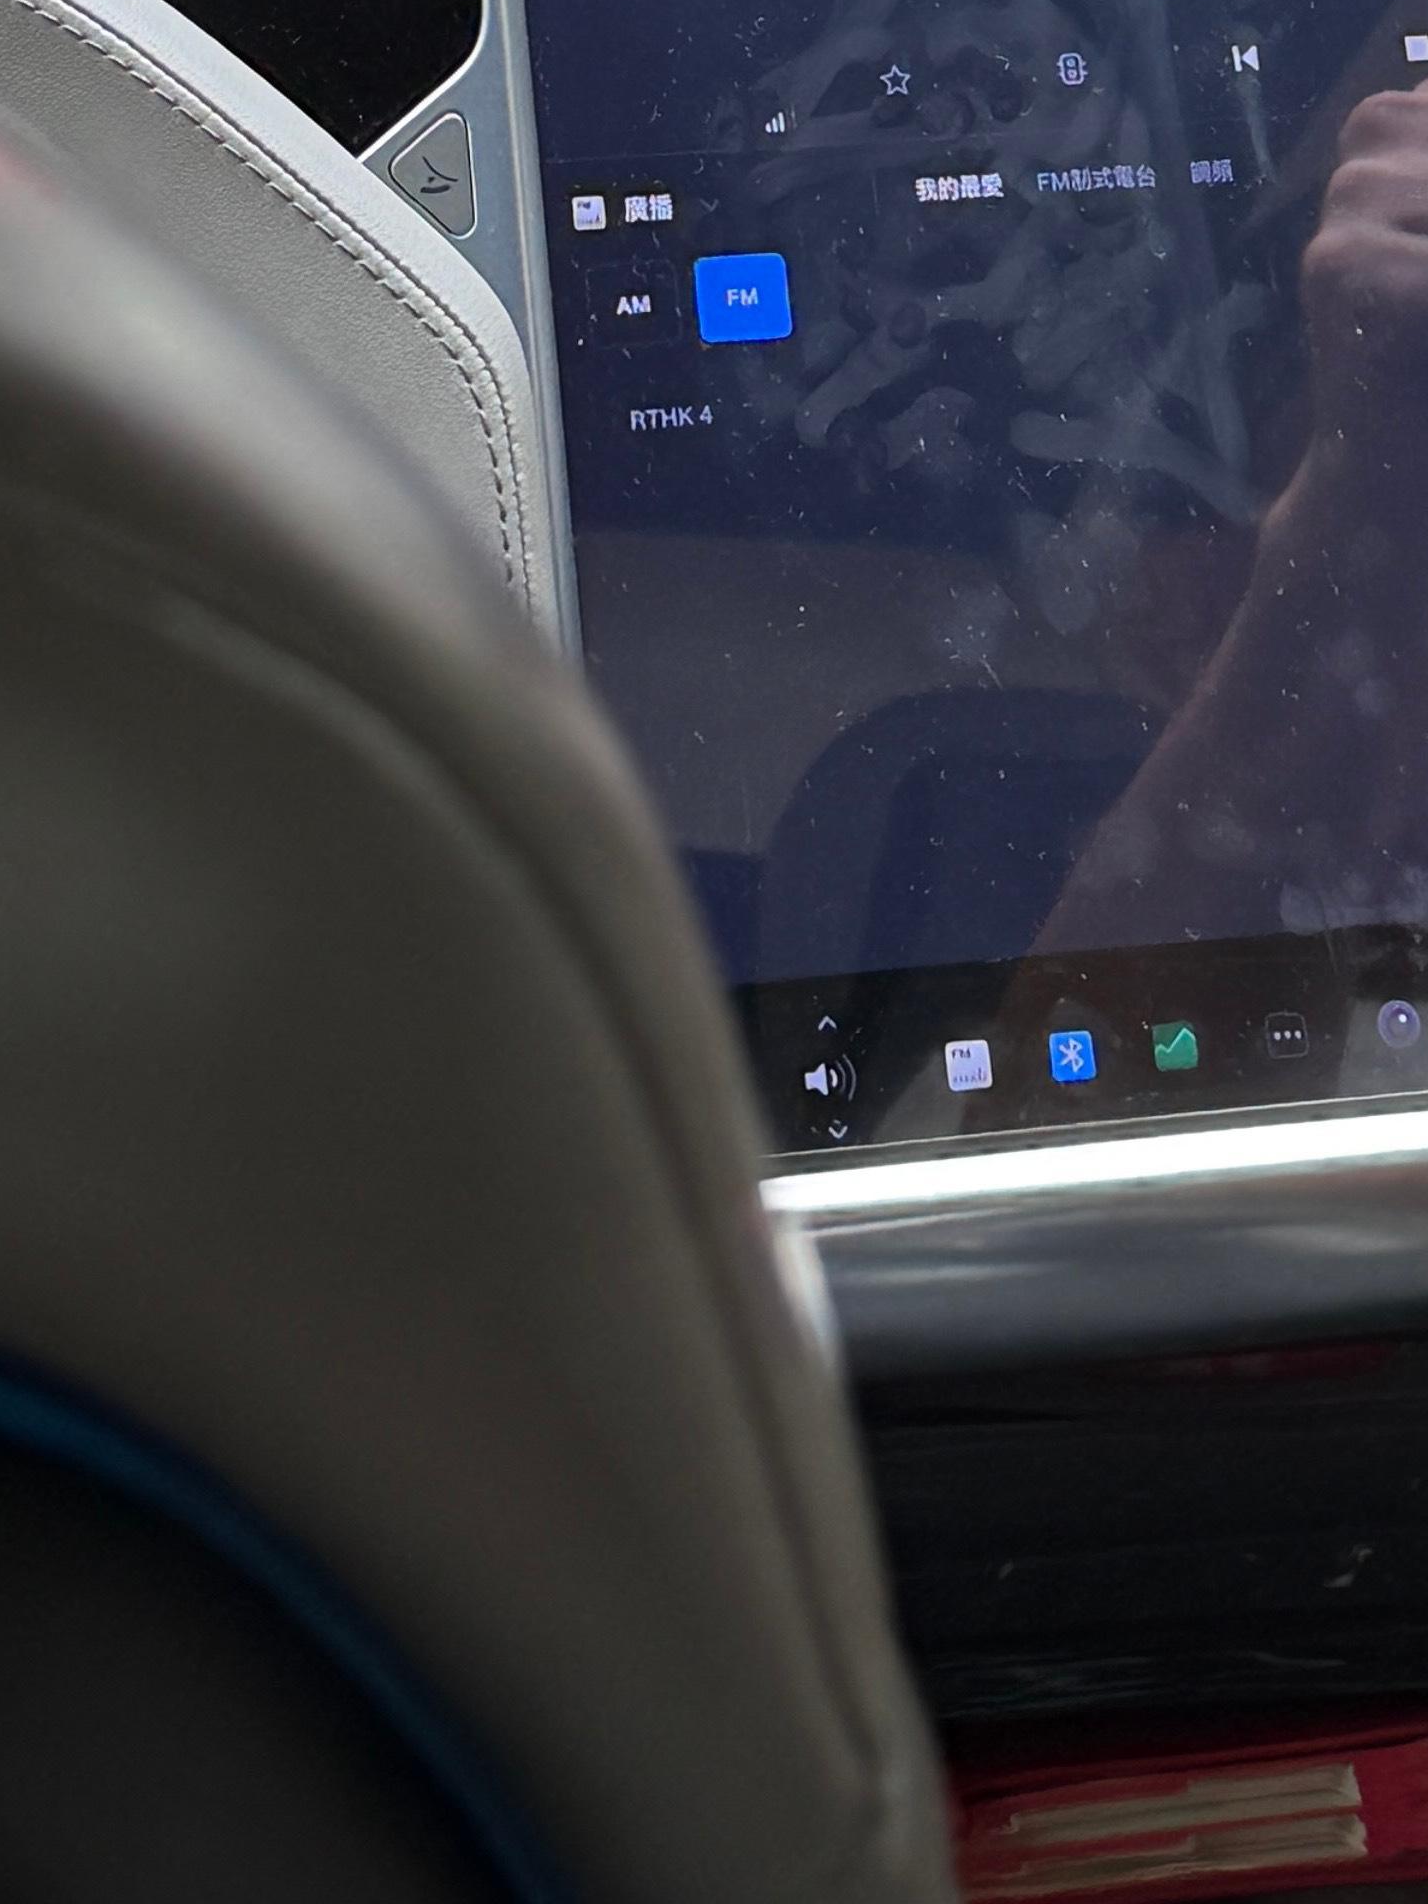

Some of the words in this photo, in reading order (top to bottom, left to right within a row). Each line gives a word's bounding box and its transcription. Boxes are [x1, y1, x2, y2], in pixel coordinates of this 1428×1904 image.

[914, 172, 1005, 202] 我的最愛
[624, 193, 673, 223] 廣播
[616, 294, 652, 316] AM
[727, 287, 760, 307] FM
[630, 406, 695, 431] RTHK
[699, 404, 714, 426] 4
